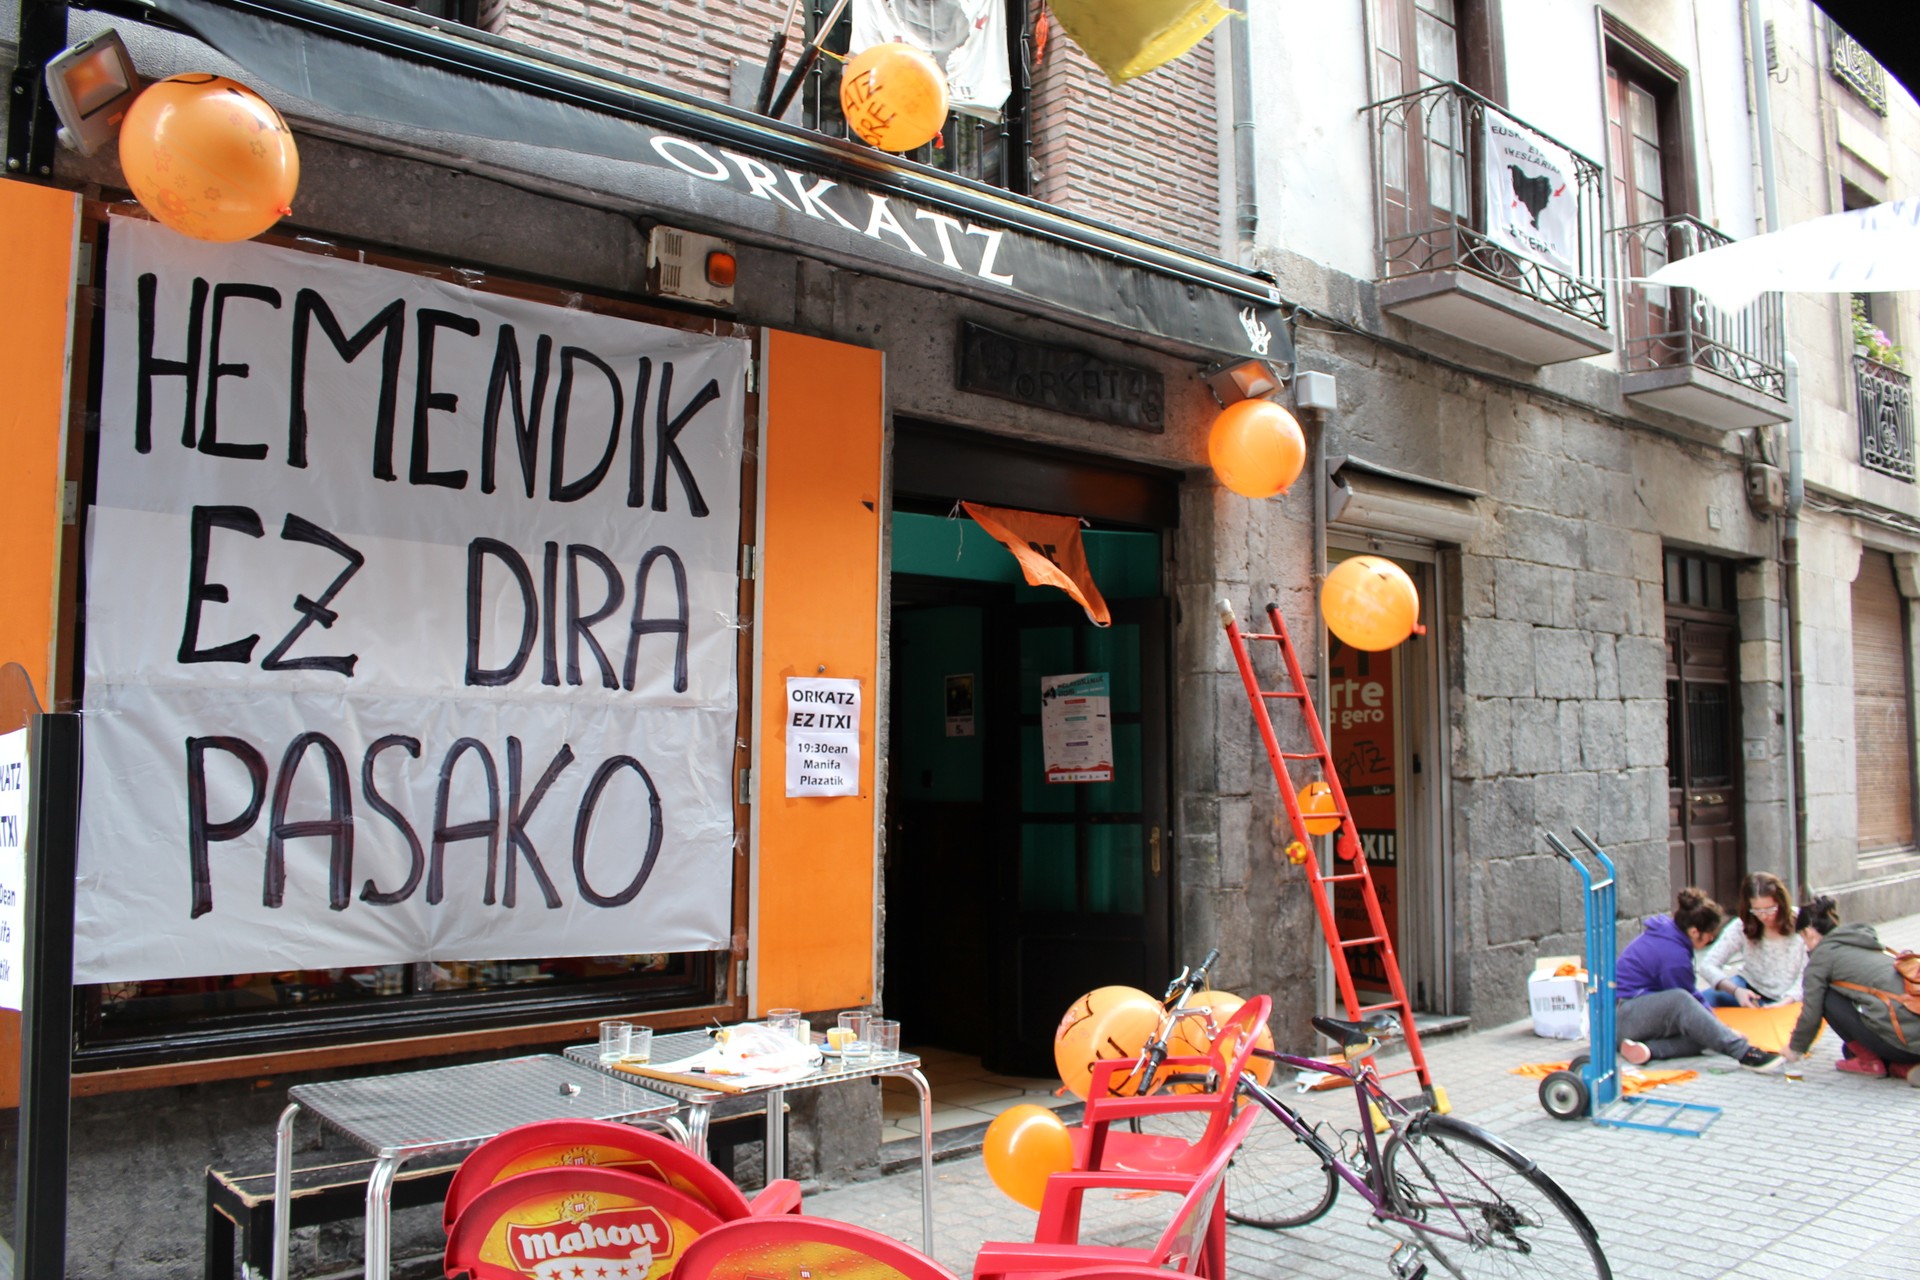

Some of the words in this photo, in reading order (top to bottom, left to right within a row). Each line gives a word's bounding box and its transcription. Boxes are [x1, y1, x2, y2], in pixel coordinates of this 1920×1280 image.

[650, 136, 1014, 286] ORKATZ
[135, 272, 720, 517] HEMENDIK
[178, 505, 365, 677] EZ
[465, 536, 688, 692] DIRA
[792, 690, 855, 705] ORKATZ
[792, 713, 815, 727] EZ
[820, 714, 851, 729] ITXI
[1342, 709, 1384, 729] gero
[798, 743, 848, 754] 19:30ean
[803, 759, 841, 769] Manifa
[800, 775, 843, 785] Plazatik
[187, 731, 663, 919] PASAKO
[518, 1222, 660, 1260] Mahou
